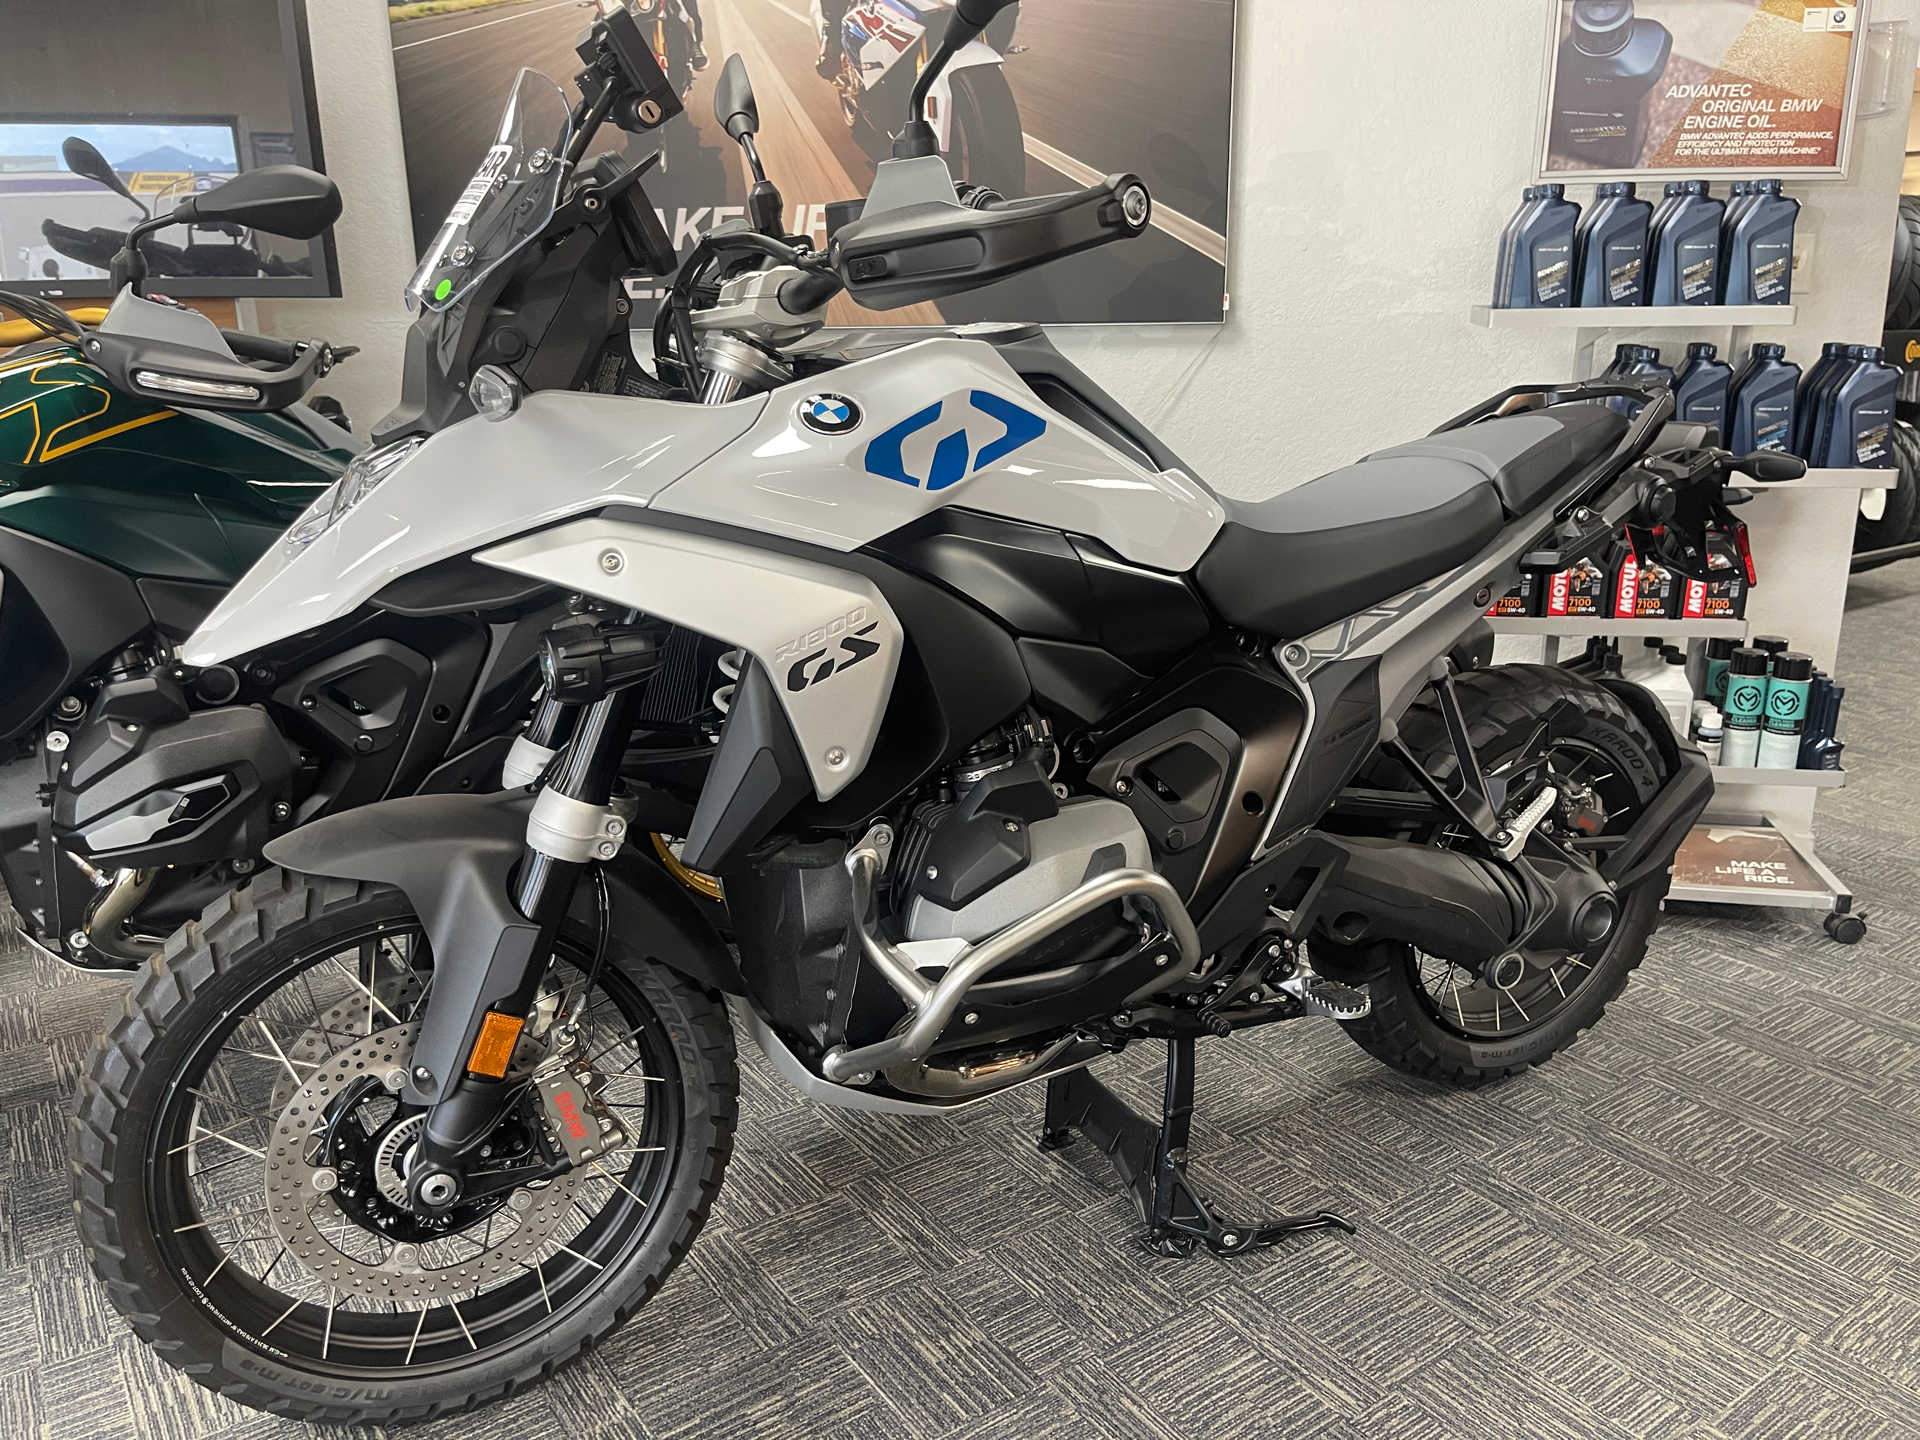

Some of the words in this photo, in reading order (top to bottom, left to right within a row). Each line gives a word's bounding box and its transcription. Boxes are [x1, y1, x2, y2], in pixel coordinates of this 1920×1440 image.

[1665, 84, 1752, 99] ADVANTEC
[1702, 99, 1776, 113] ORIGINAL
[1780, 98, 1823, 112] BMW
[1683, 115, 1745, 129] ENGINE
[1747, 114, 1776, 128] OIL.
[1680, 132, 1702, 140] BMW
[1702, 132, 1745, 140] ADVANTEC
[1746, 131, 1769, 139] ADDS
[1770, 131, 1833, 140] PERFORMANCE,
[1677, 140, 1724, 148] EFFICIENCY
[1743, 139, 1795, 147] PROTECTION
[1674, 148, 1692, 156] FOR
[1694, 148, 1710, 156] THE
[1711, 147, 1750, 155] ULTIMATE
[1750, 147, 1778, 155] RIDING
[1619, 561, 1637, 614] MOTUL
[1688, 580, 1704, 613] MOT
[1499, 599, 1521, 607] 7100
[1569, 598, 1592, 607] 7100
[1637, 600, 1660, 609] 7100
[1706, 600, 1729, 609] 7100
[786, 620, 881, 692] GS
[1589, 726, 1645, 770] KAROO
[1731, 860, 1787, 870] MAKE
[1715, 866, 1756, 875] LIFE
[1760, 868, 1775, 876] A
[1744, 874, 1795, 884] RIDE.
[554, 1090, 588, 1139] BMW
